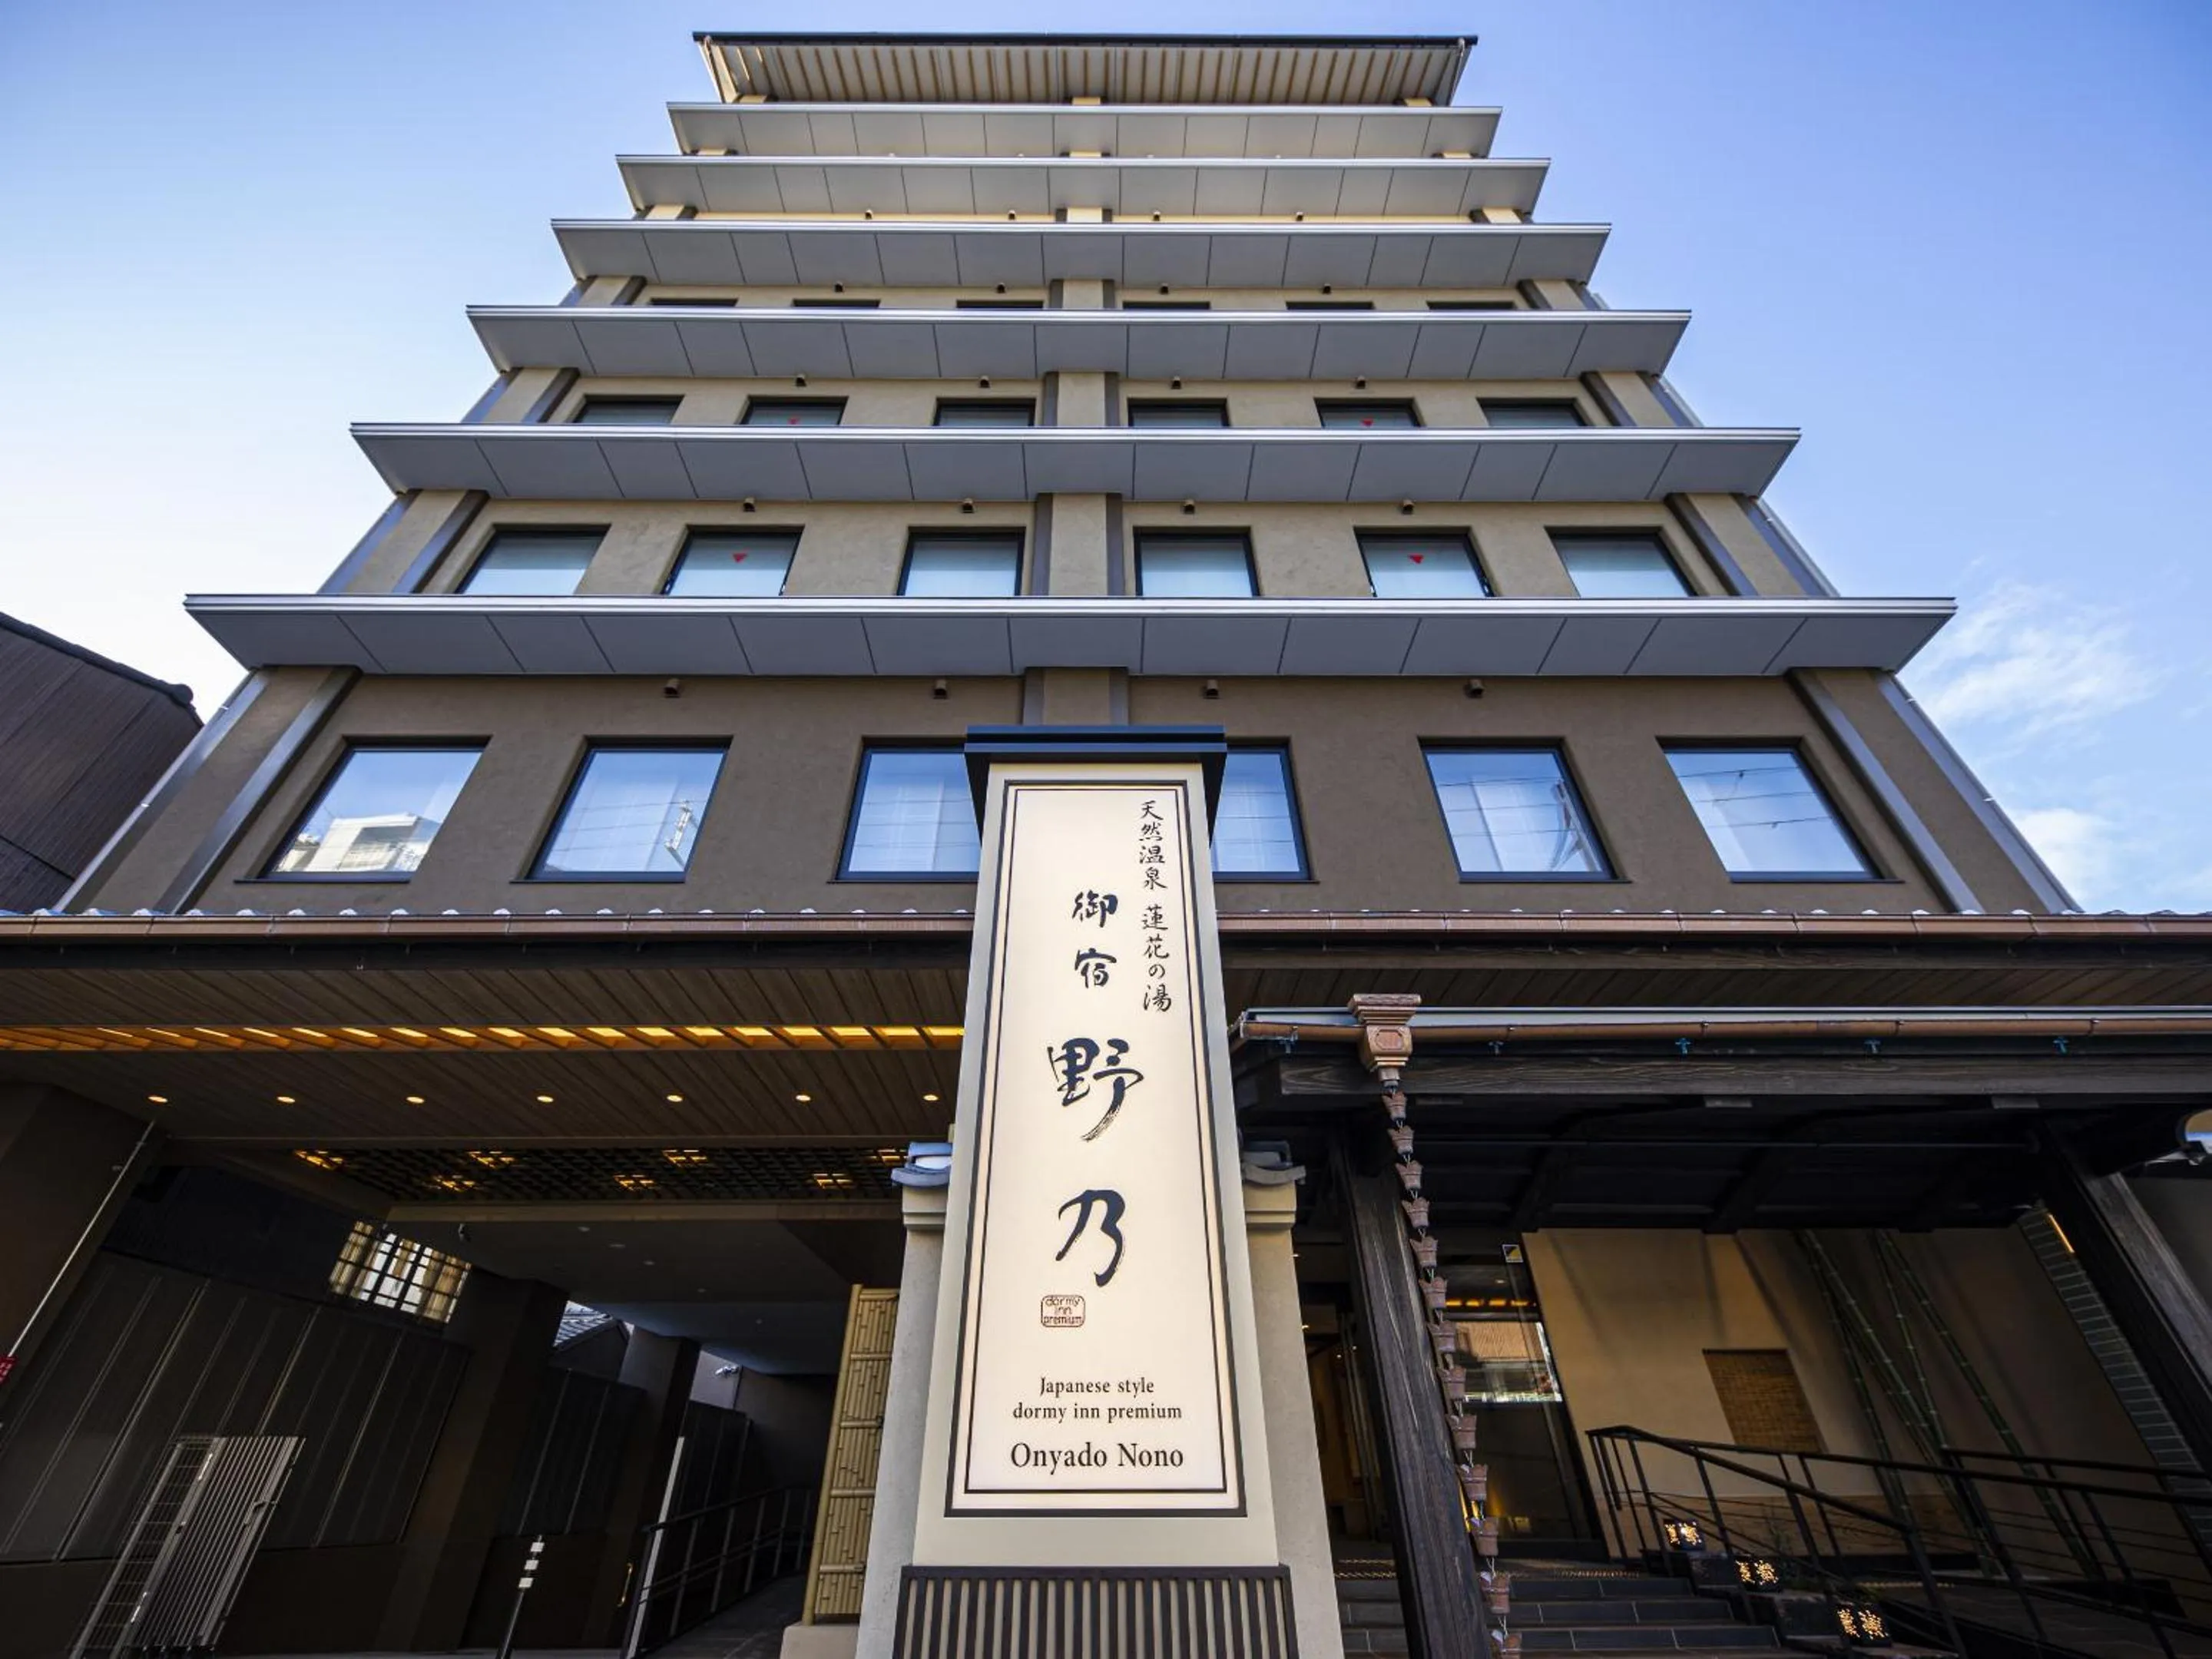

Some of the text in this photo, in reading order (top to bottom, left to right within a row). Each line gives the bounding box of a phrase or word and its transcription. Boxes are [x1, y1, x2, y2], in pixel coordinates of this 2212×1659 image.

[1138, 800, 1172, 1012] 天然温泉 蓮花の湯
[1047, 889, 1144, 1288] 御宿 野乃
[1040, 1376, 1154, 1399] Japanese style
[1012, 1402, 1182, 1424] dormy inn premium
[1010, 1441, 1184, 1475] Onyado Nono
